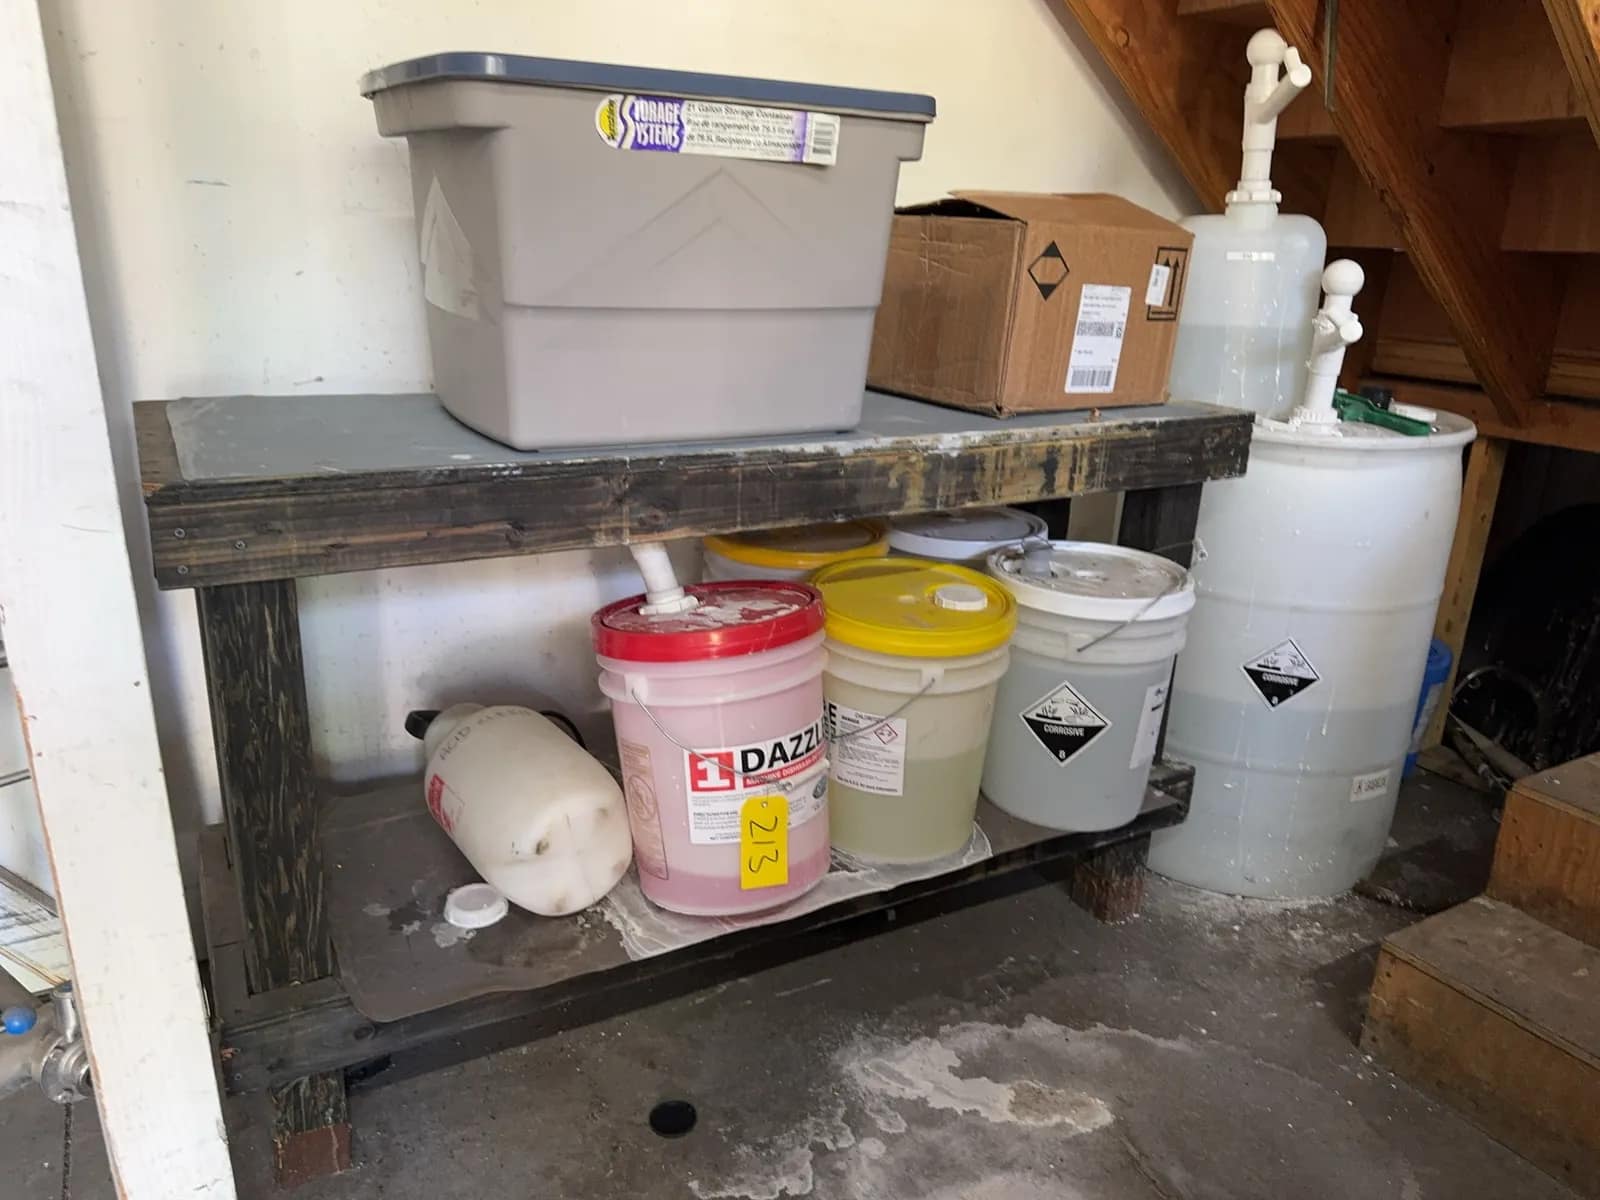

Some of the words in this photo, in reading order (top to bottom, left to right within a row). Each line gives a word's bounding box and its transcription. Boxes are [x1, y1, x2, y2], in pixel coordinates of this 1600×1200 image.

[698, 103, 723, 114] Gallon
[724, 105, 754, 118] Storage
[756, 110, 793, 120] Container
[1262, 672, 1299, 687] CORROSIVE
[1043, 723, 1085, 737] CORROSIVE
[740, 722, 823, 773] DAZZL
[697, 757, 730, 788] 1
[748, 815, 779, 874] 213
